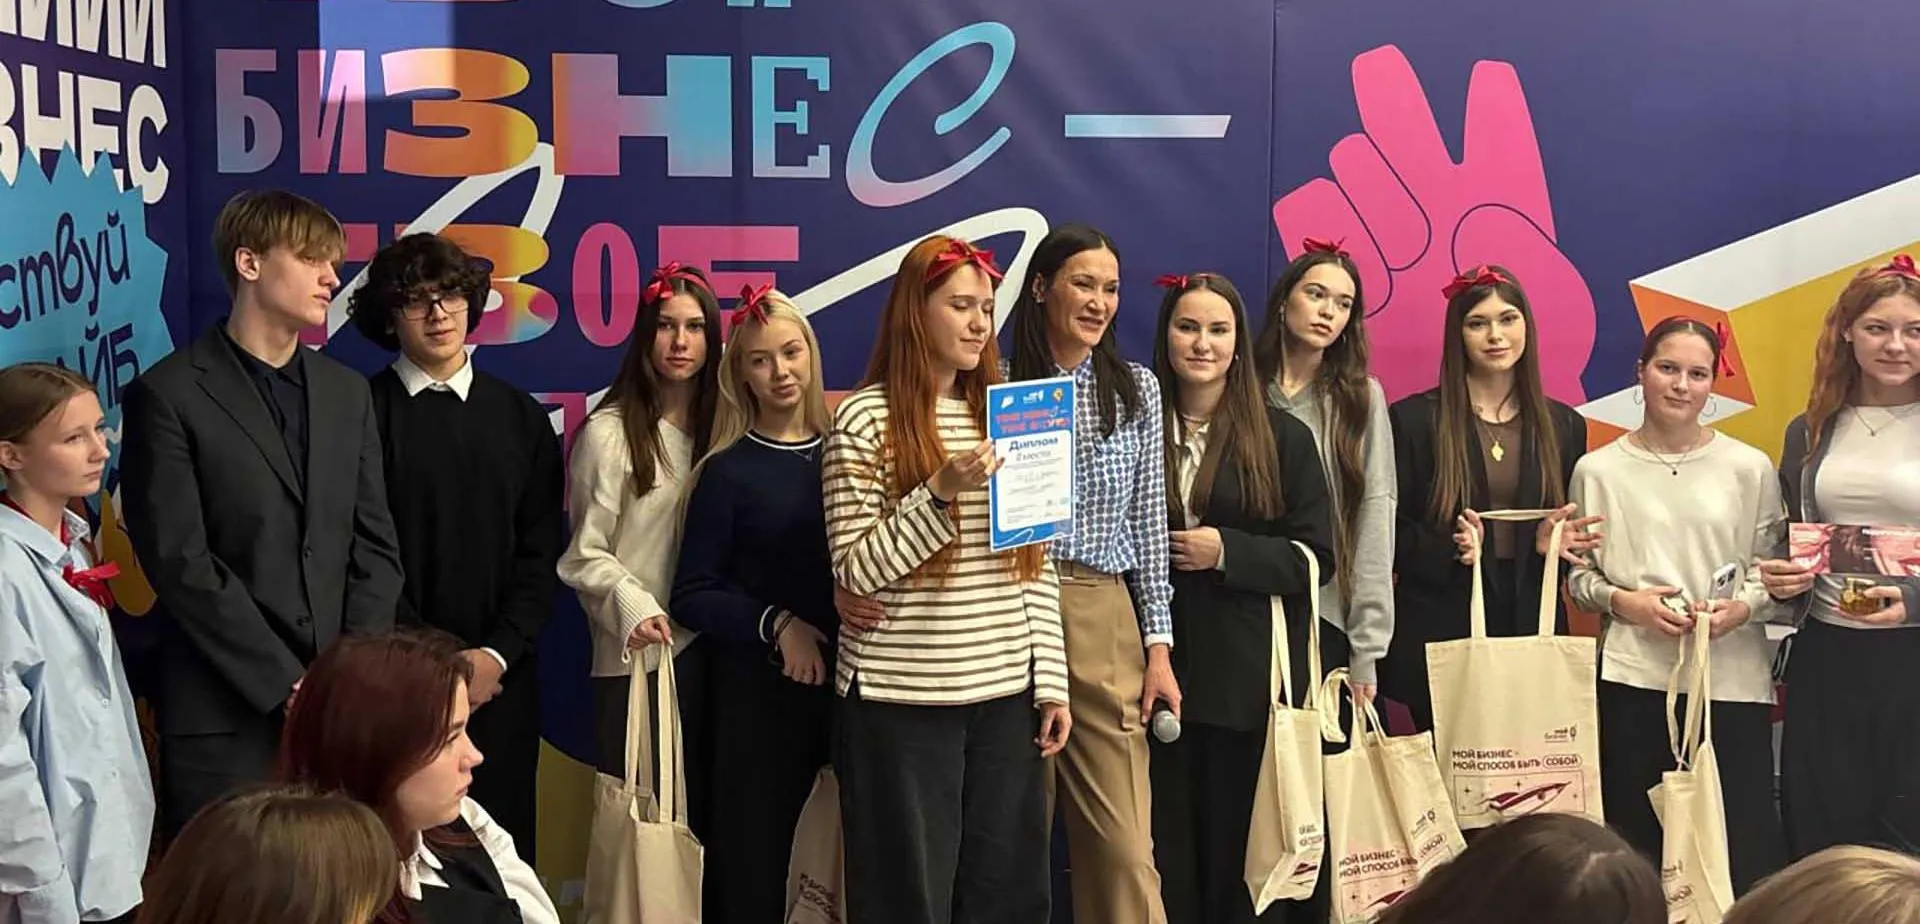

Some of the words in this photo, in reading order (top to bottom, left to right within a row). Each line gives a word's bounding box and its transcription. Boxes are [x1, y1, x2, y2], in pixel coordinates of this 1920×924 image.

[215, 22, 1016, 207] БИЗНЕС
[1476, 760, 1516, 771] СПОСОБ
[1545, 754, 1579, 766] СОБОЙ
